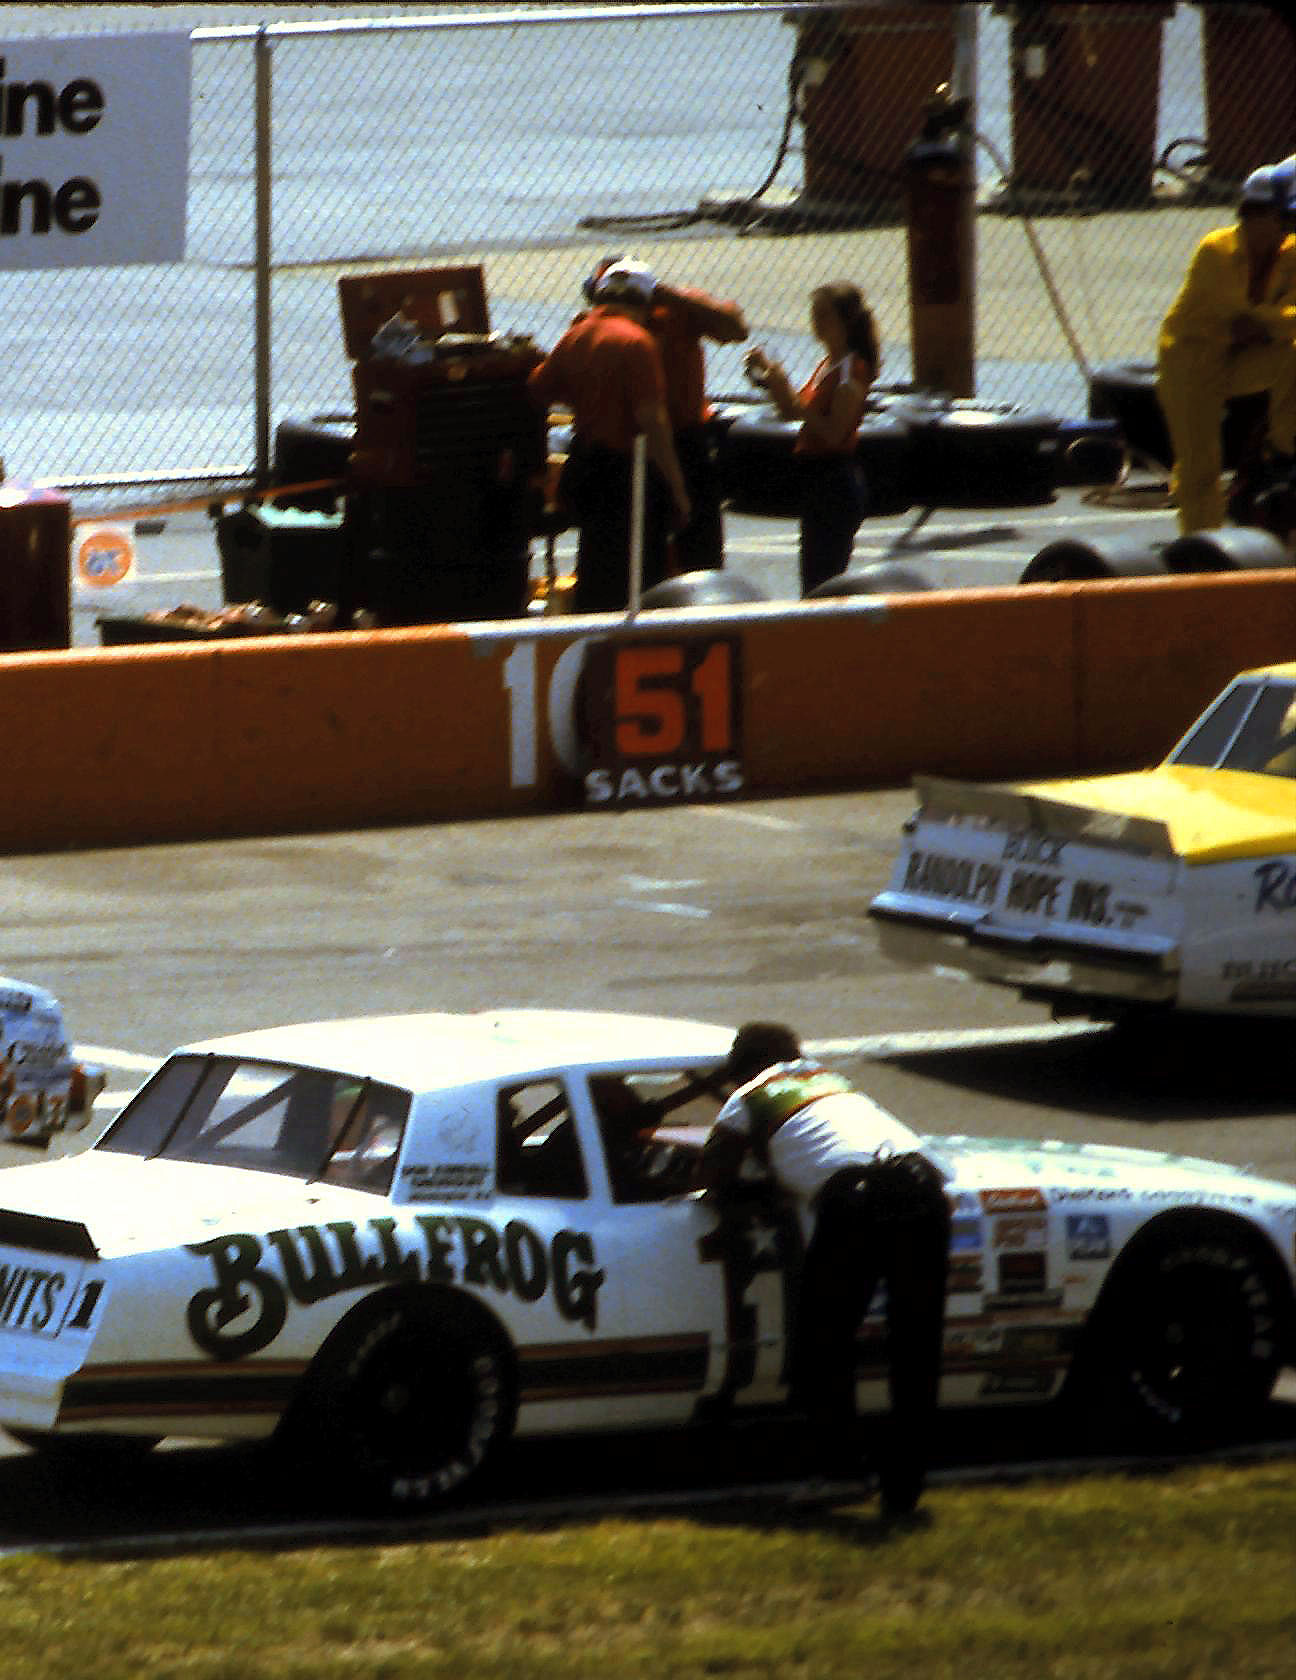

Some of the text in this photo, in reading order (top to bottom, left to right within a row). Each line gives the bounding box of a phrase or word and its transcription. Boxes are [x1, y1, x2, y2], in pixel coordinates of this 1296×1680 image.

[615, 642, 731, 754] 51
[584, 760, 745, 801] SACKS
[68, 1278, 106, 1330] 1
[181, 1216, 606, 1360] BULLFROG
